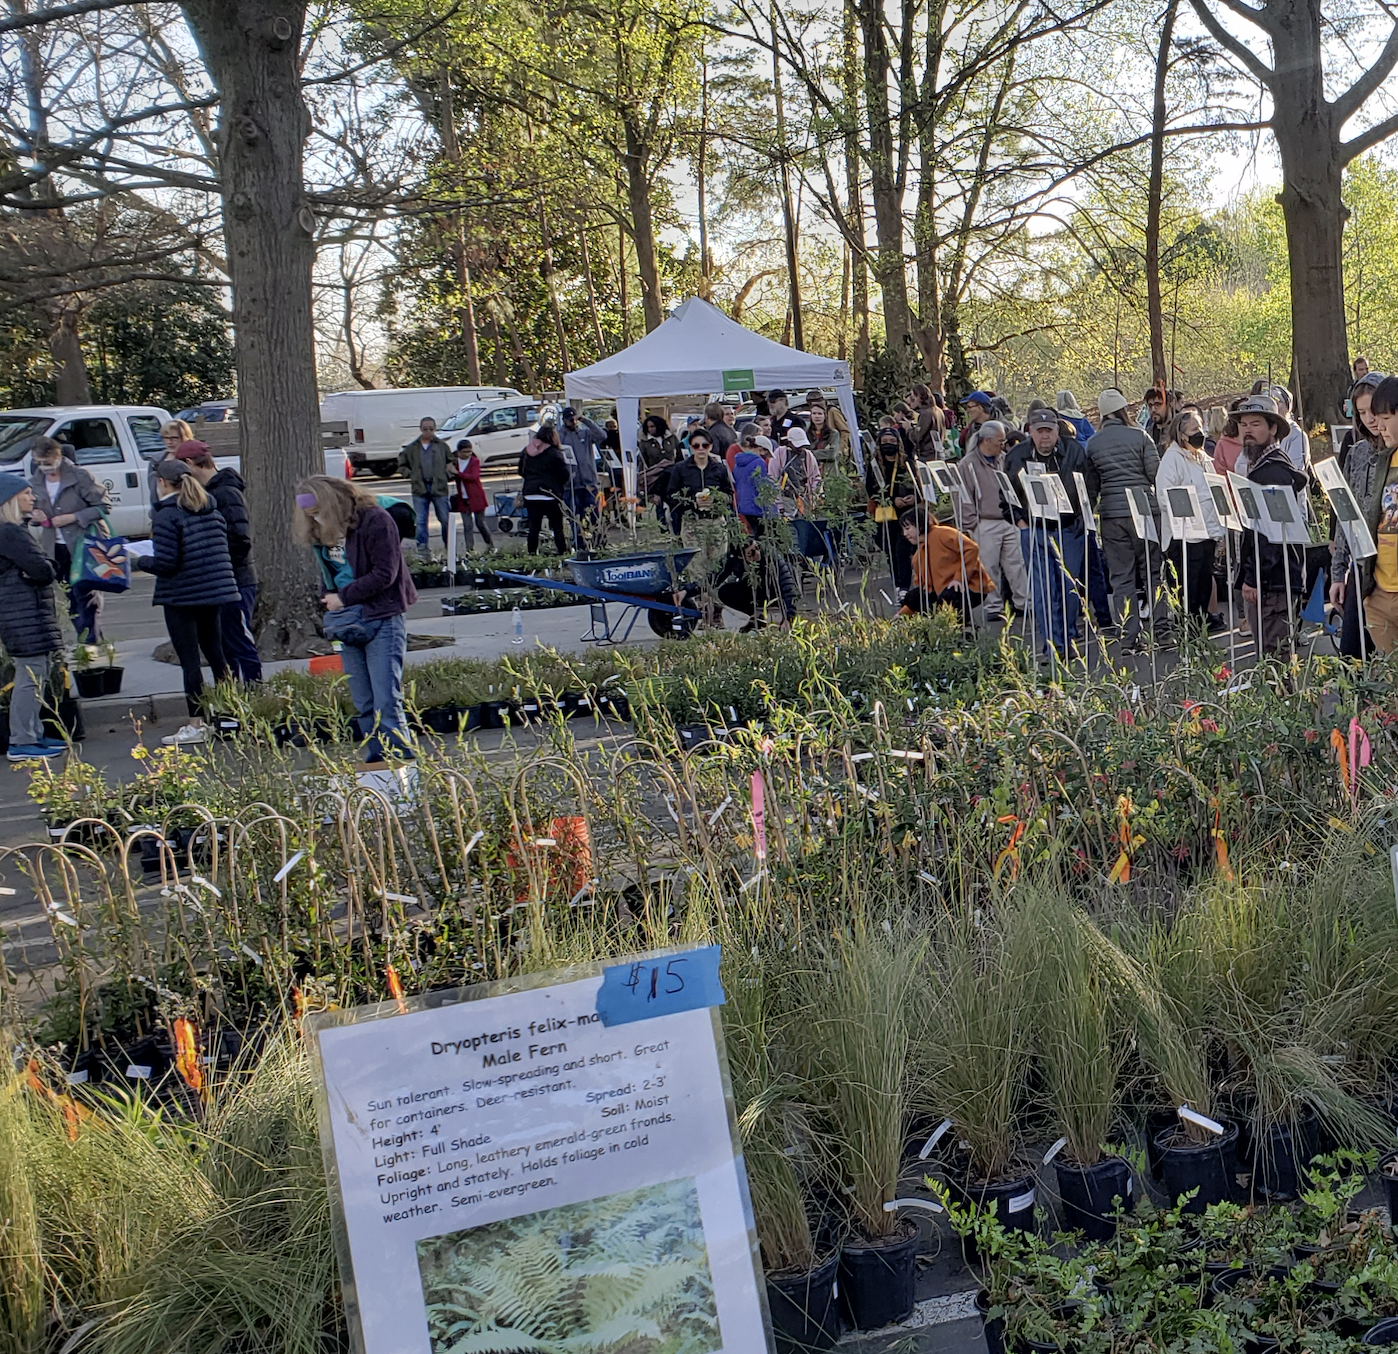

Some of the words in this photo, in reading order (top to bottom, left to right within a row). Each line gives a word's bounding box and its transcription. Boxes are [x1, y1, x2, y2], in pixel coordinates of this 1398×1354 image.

[621, 958, 688, 1003] $15
[430, 1026, 521, 1056] Dryopteris
[527, 1012, 604, 1037] felix-ma
[482, 1049, 522, 1069] Male
[528, 1042, 568, 1060] Fern
[367, 1099, 393, 1113] Sun
[396, 1086, 450, 1107] tolerant.
[462, 1064, 560, 1092] Slow-spreading
[562, 1056, 586, 1072] and
[588, 1050, 627, 1066] short.
[633, 1040, 670, 1057] Great
[369, 1117, 392, 1132] for
[395, 1102, 468, 1126] containers.
[475, 1079, 576, 1109] Deer-resistant.
[371, 1130, 424, 1150] Height:
[585, 1082, 637, 1105] Spread:
[374, 1151, 416, 1169] Light:
[421, 1141, 446, 1158] Full
[450, 1133, 492, 1152] Shade
[600, 1102, 630, 1118] Soil:
[634, 1094, 670, 1111] Moist
[376, 1166, 431, 1187] Foliage:
[437, 1158, 473, 1174] Long,
[475, 1145, 531, 1165] leathery
[534, 1123, 628, 1152] emerald-green
[629, 1112, 676, 1131] fronds.
[380, 1184, 433, 1206] Upright
[436, 1176, 460, 1193] and
[463, 1166, 514, 1187] stately.
[520, 1155, 558, 1174] Holds
[561, 1147, 606, 1165] foliage
[608, 1142, 621, 1153] in
[623, 1134, 650, 1150] cold
[382, 1203, 443, 1224] weather.
[450, 1177, 558, 1208] Semi-evergreen.
